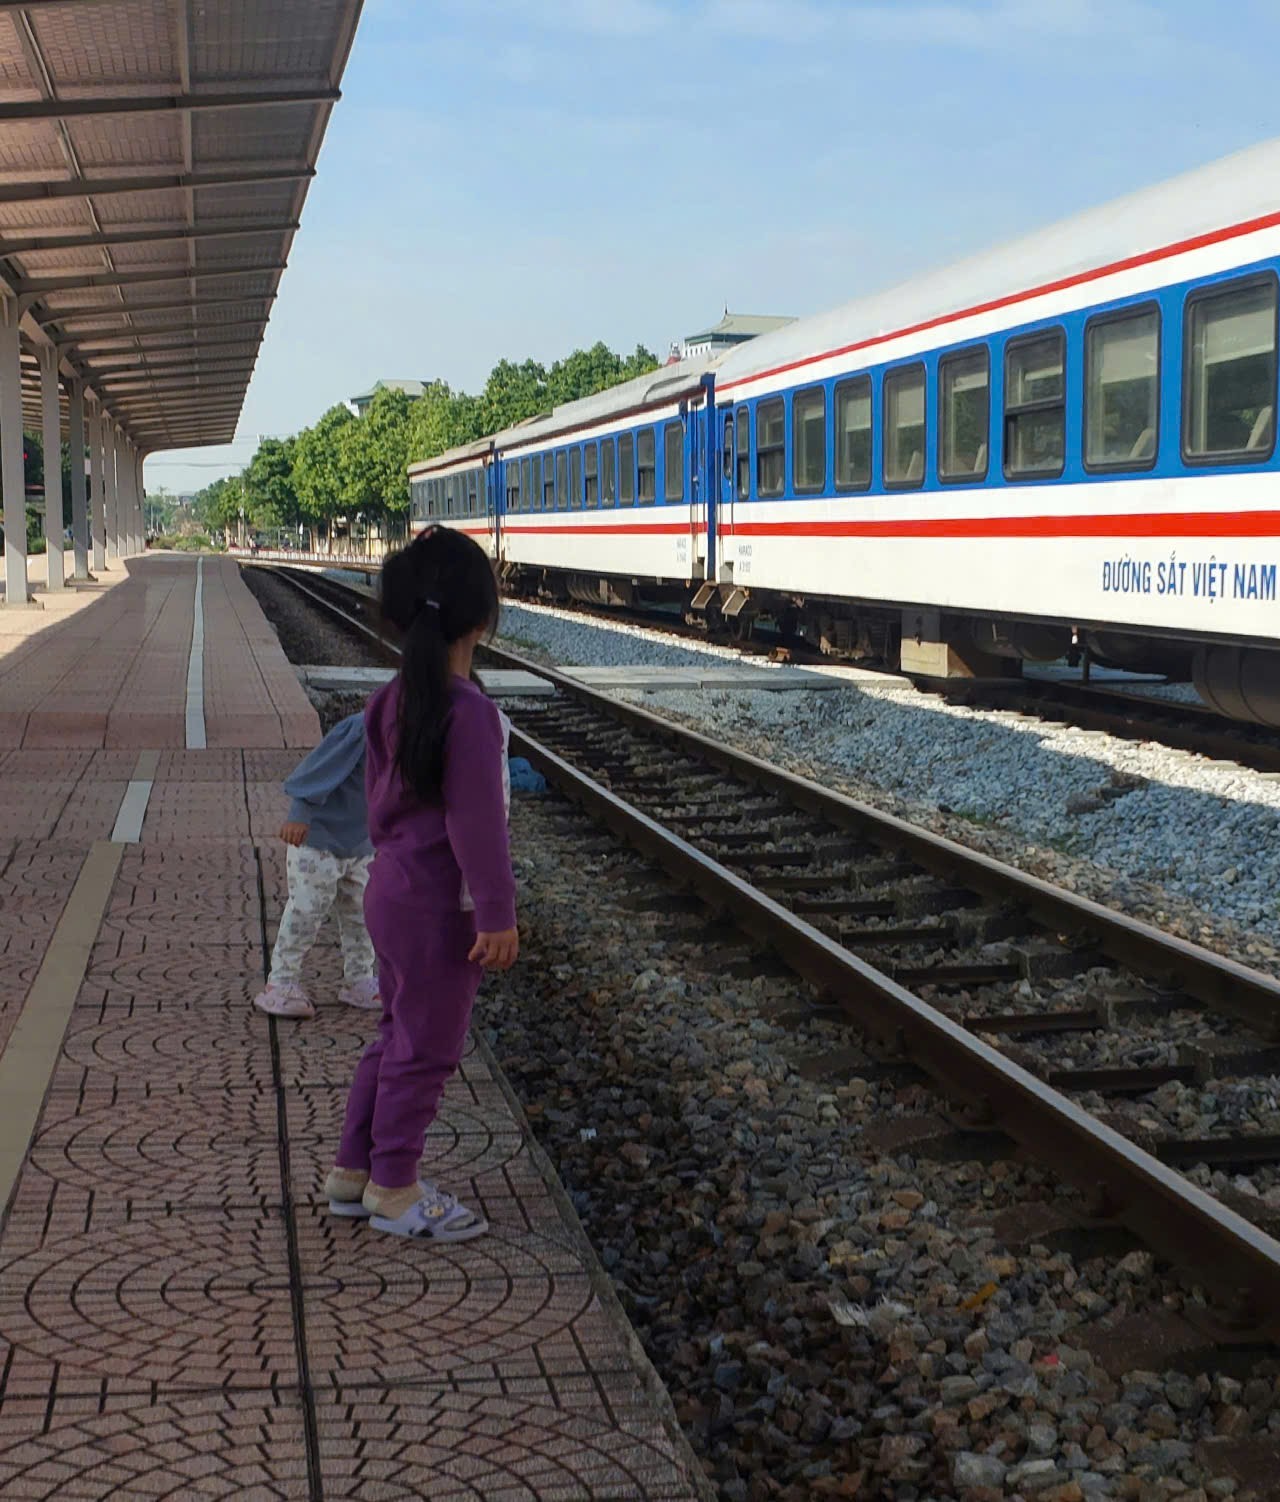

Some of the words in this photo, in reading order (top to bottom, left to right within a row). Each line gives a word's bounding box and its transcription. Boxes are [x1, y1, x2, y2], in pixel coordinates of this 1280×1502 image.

[1102, 553, 1151, 593] ĐƯỜNG
[1157, 550, 1187, 596] SẮT
[1193, 555, 1228, 604] VIỆT
[1233, 563, 1277, 601] NAM
